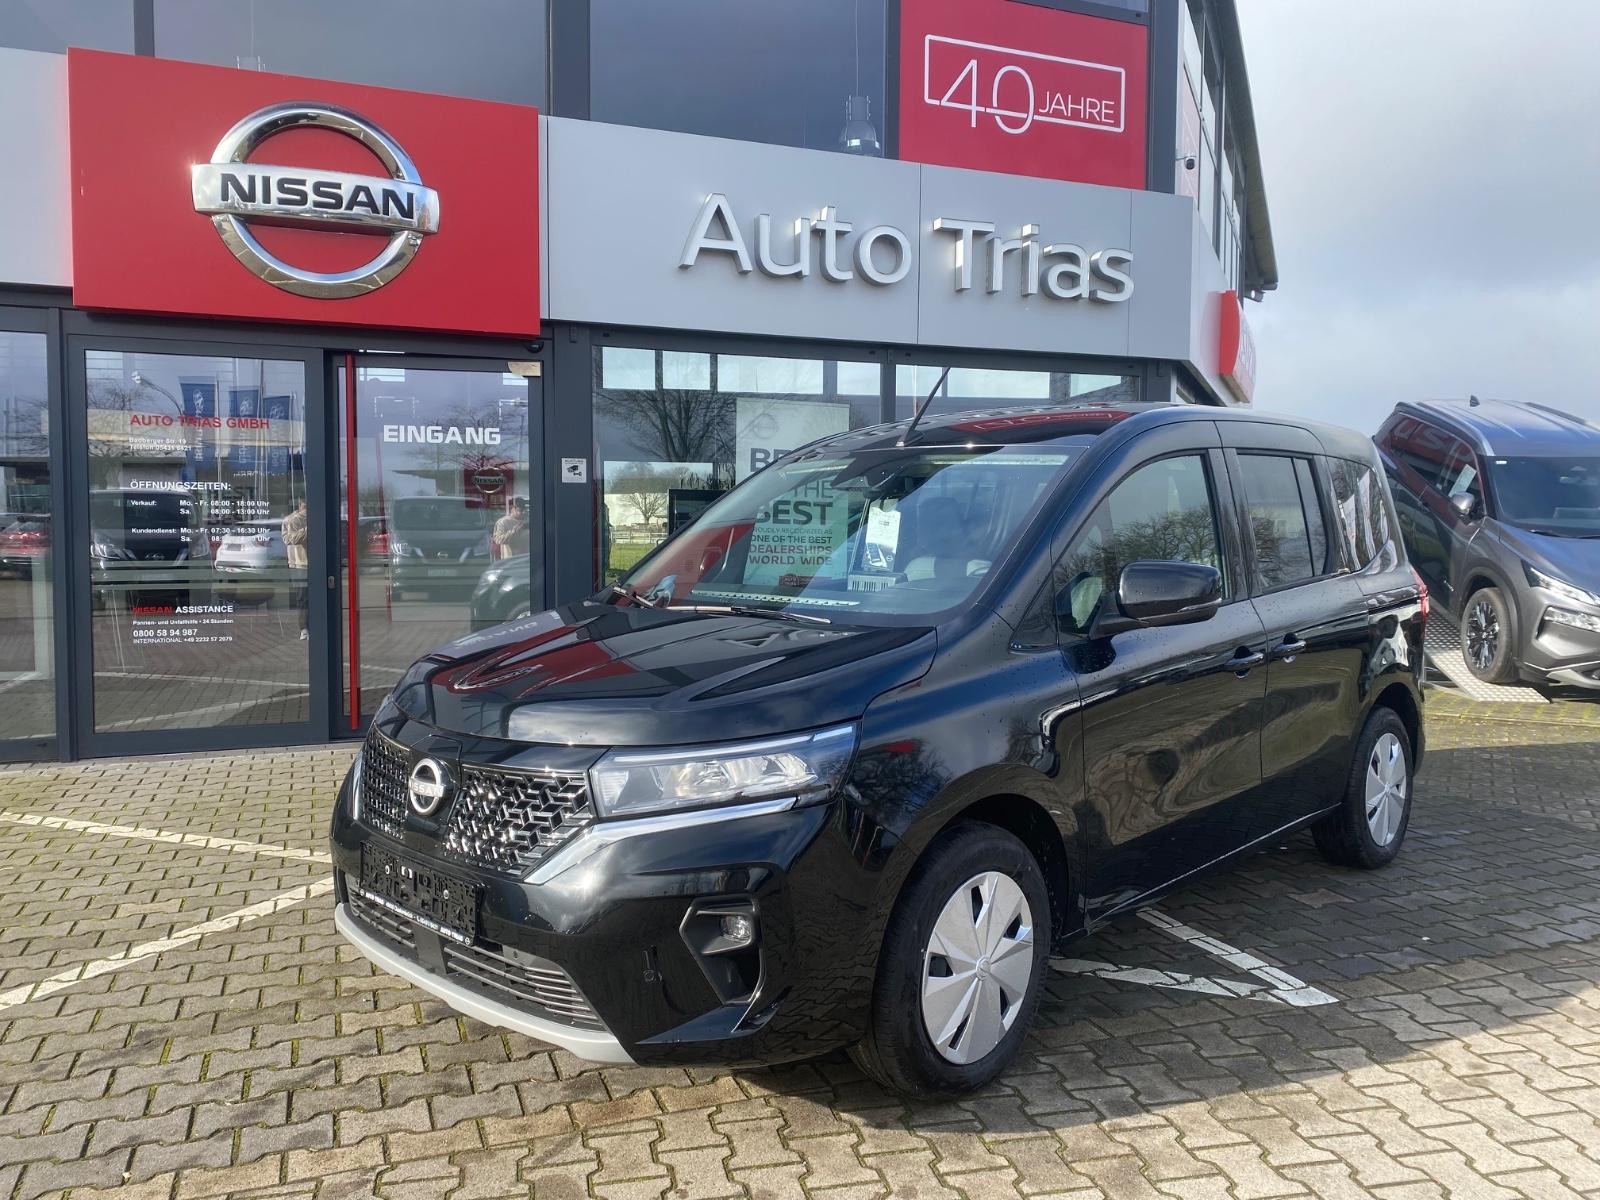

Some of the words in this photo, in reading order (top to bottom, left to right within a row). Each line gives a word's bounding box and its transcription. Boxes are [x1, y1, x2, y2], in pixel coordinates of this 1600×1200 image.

[941, 59, 1035, 135] 40
[1038, 91, 1115, 123] JAHRE
[220, 173, 414, 219] NISSAN
[678, 192, 912, 287] Auto
[932, 217, 1135, 303] Trias
[130, 414, 173, 426] AUTO
[179, 415, 221, 428] TRIAS
[226, 417, 270, 429] GMBH
[383, 424, 501, 445] EINGANG
[130, 479, 231, 491] ÖFFNUNGSZEITEN:
[793, 480, 834, 499] THE
[751, 535, 771, 543] ONE
[772, 535, 786, 543] OF
[788, 535, 807, 544] THE
[808, 536, 833, 544] BEST
[749, 544, 833, 555] DEALERSHIPS
[748, 555, 795, 565] WORLD
[800, 556, 833, 566] WIDE
[175, 605, 234, 614] ASSISTANCE
[133, 629, 155, 637] 0800
[182, 628, 198, 636] 987
[409, 781, 442, 797] ISSAN
